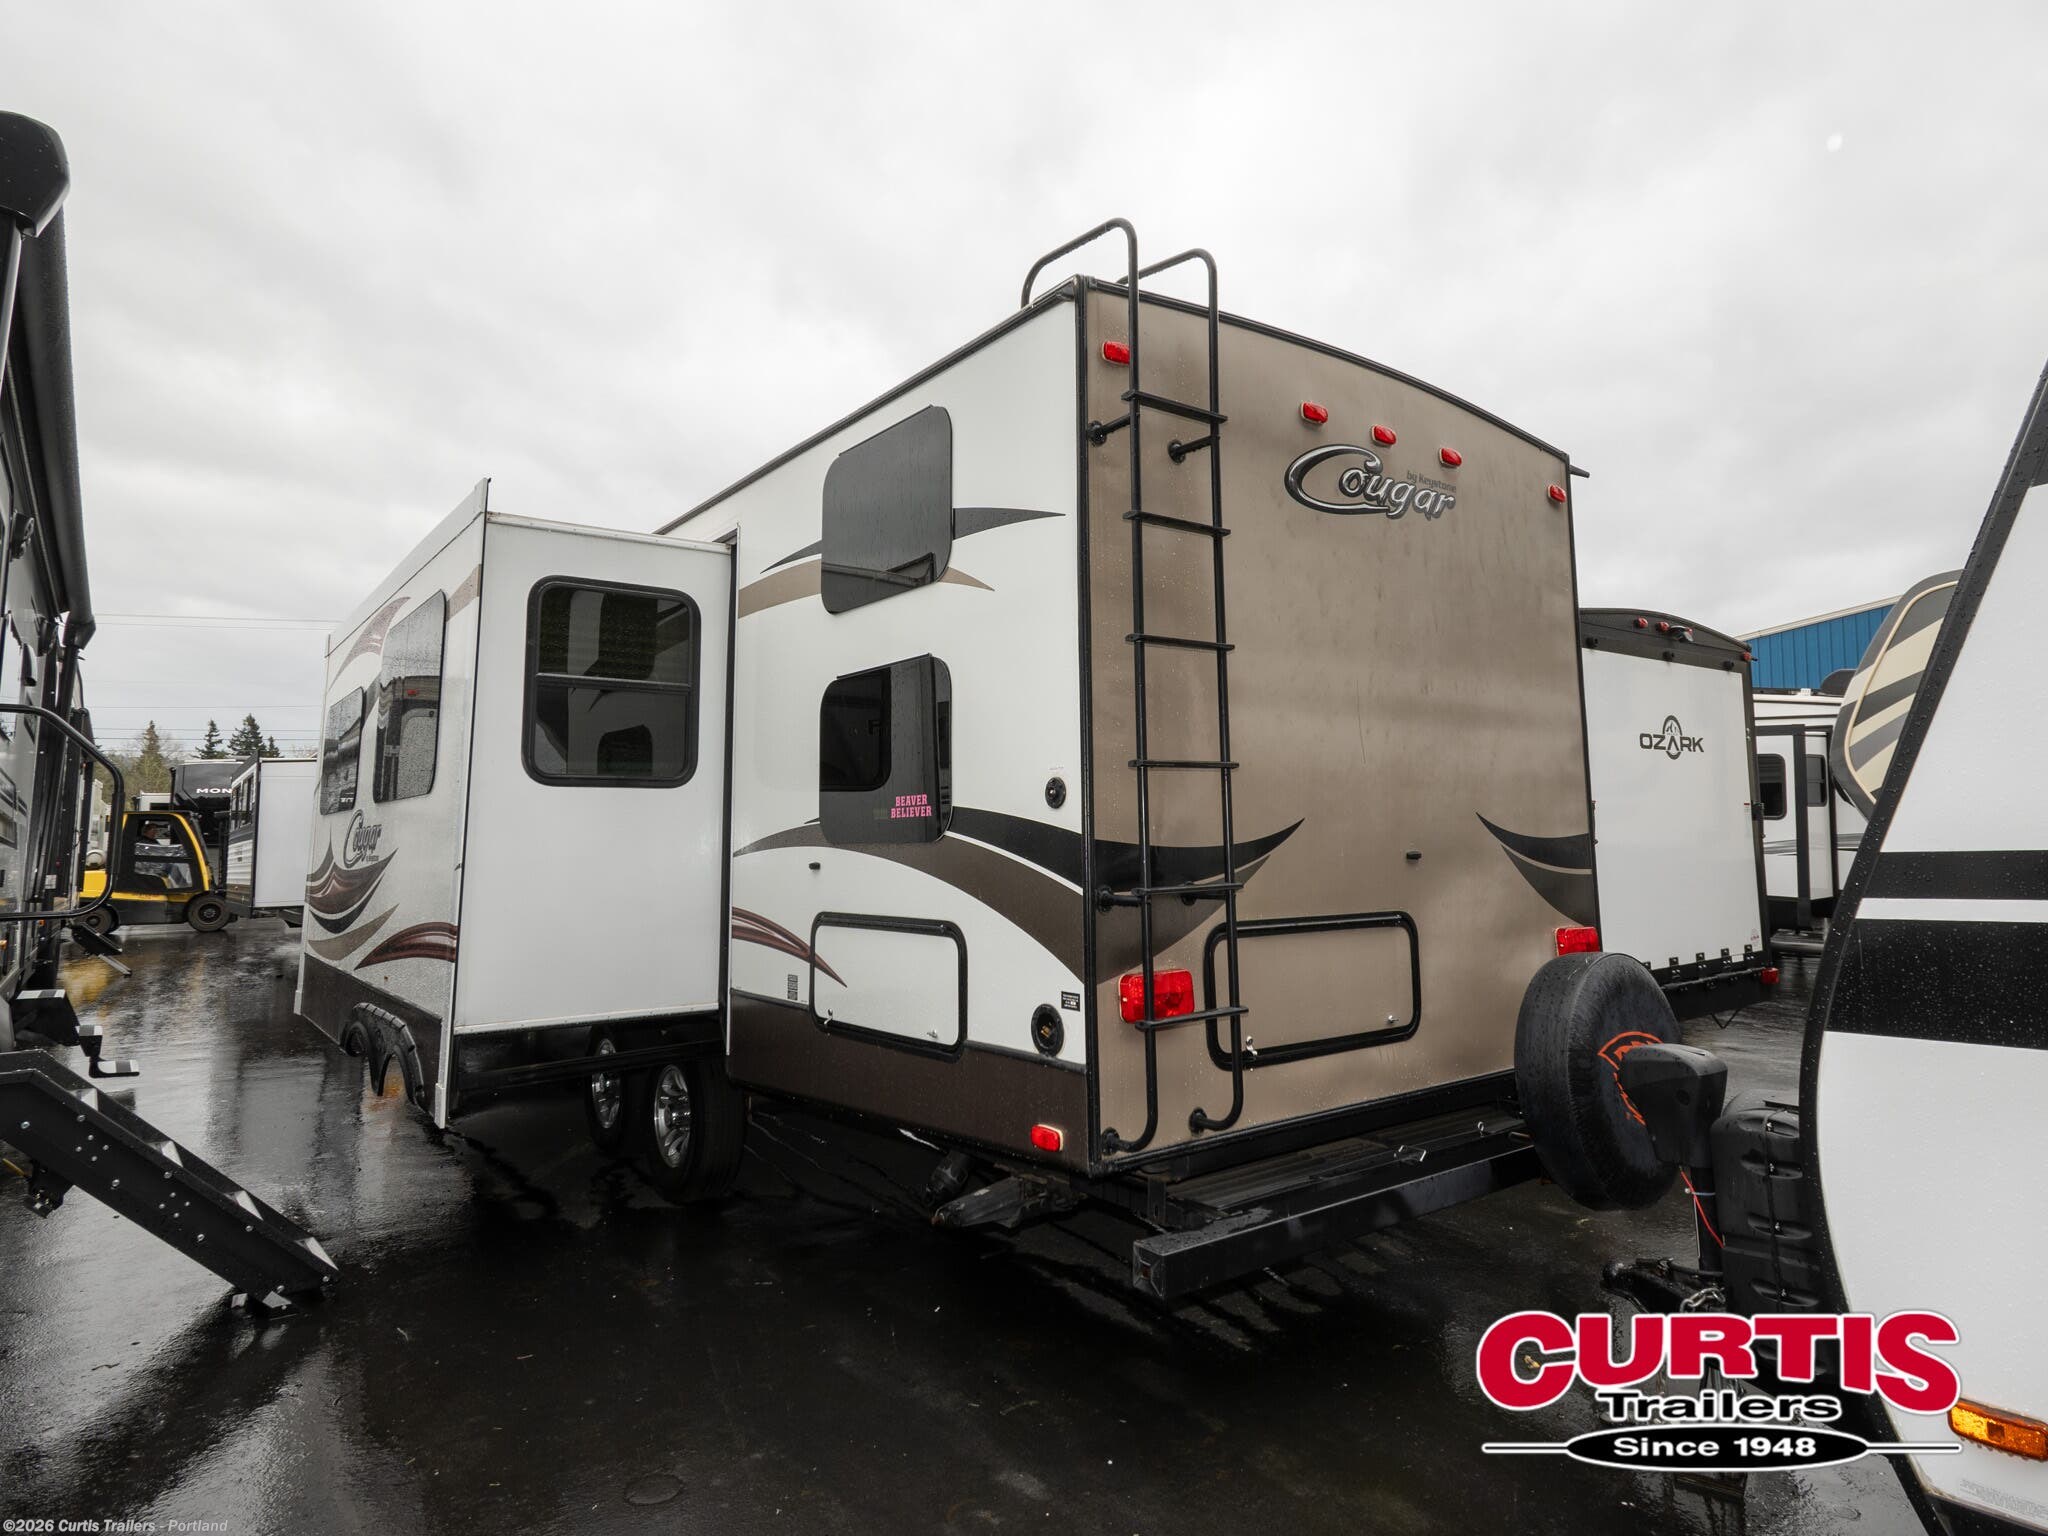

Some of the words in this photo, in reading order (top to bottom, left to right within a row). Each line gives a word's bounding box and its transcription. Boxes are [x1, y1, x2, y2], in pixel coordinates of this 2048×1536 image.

[1284, 444, 1456, 520] Cougar
[1639, 733, 1704, 752] OZARK
[895, 794, 928, 807] BEAVER
[890, 806, 932, 818] BELIEVER
[343, 809, 382, 868] Cougar
